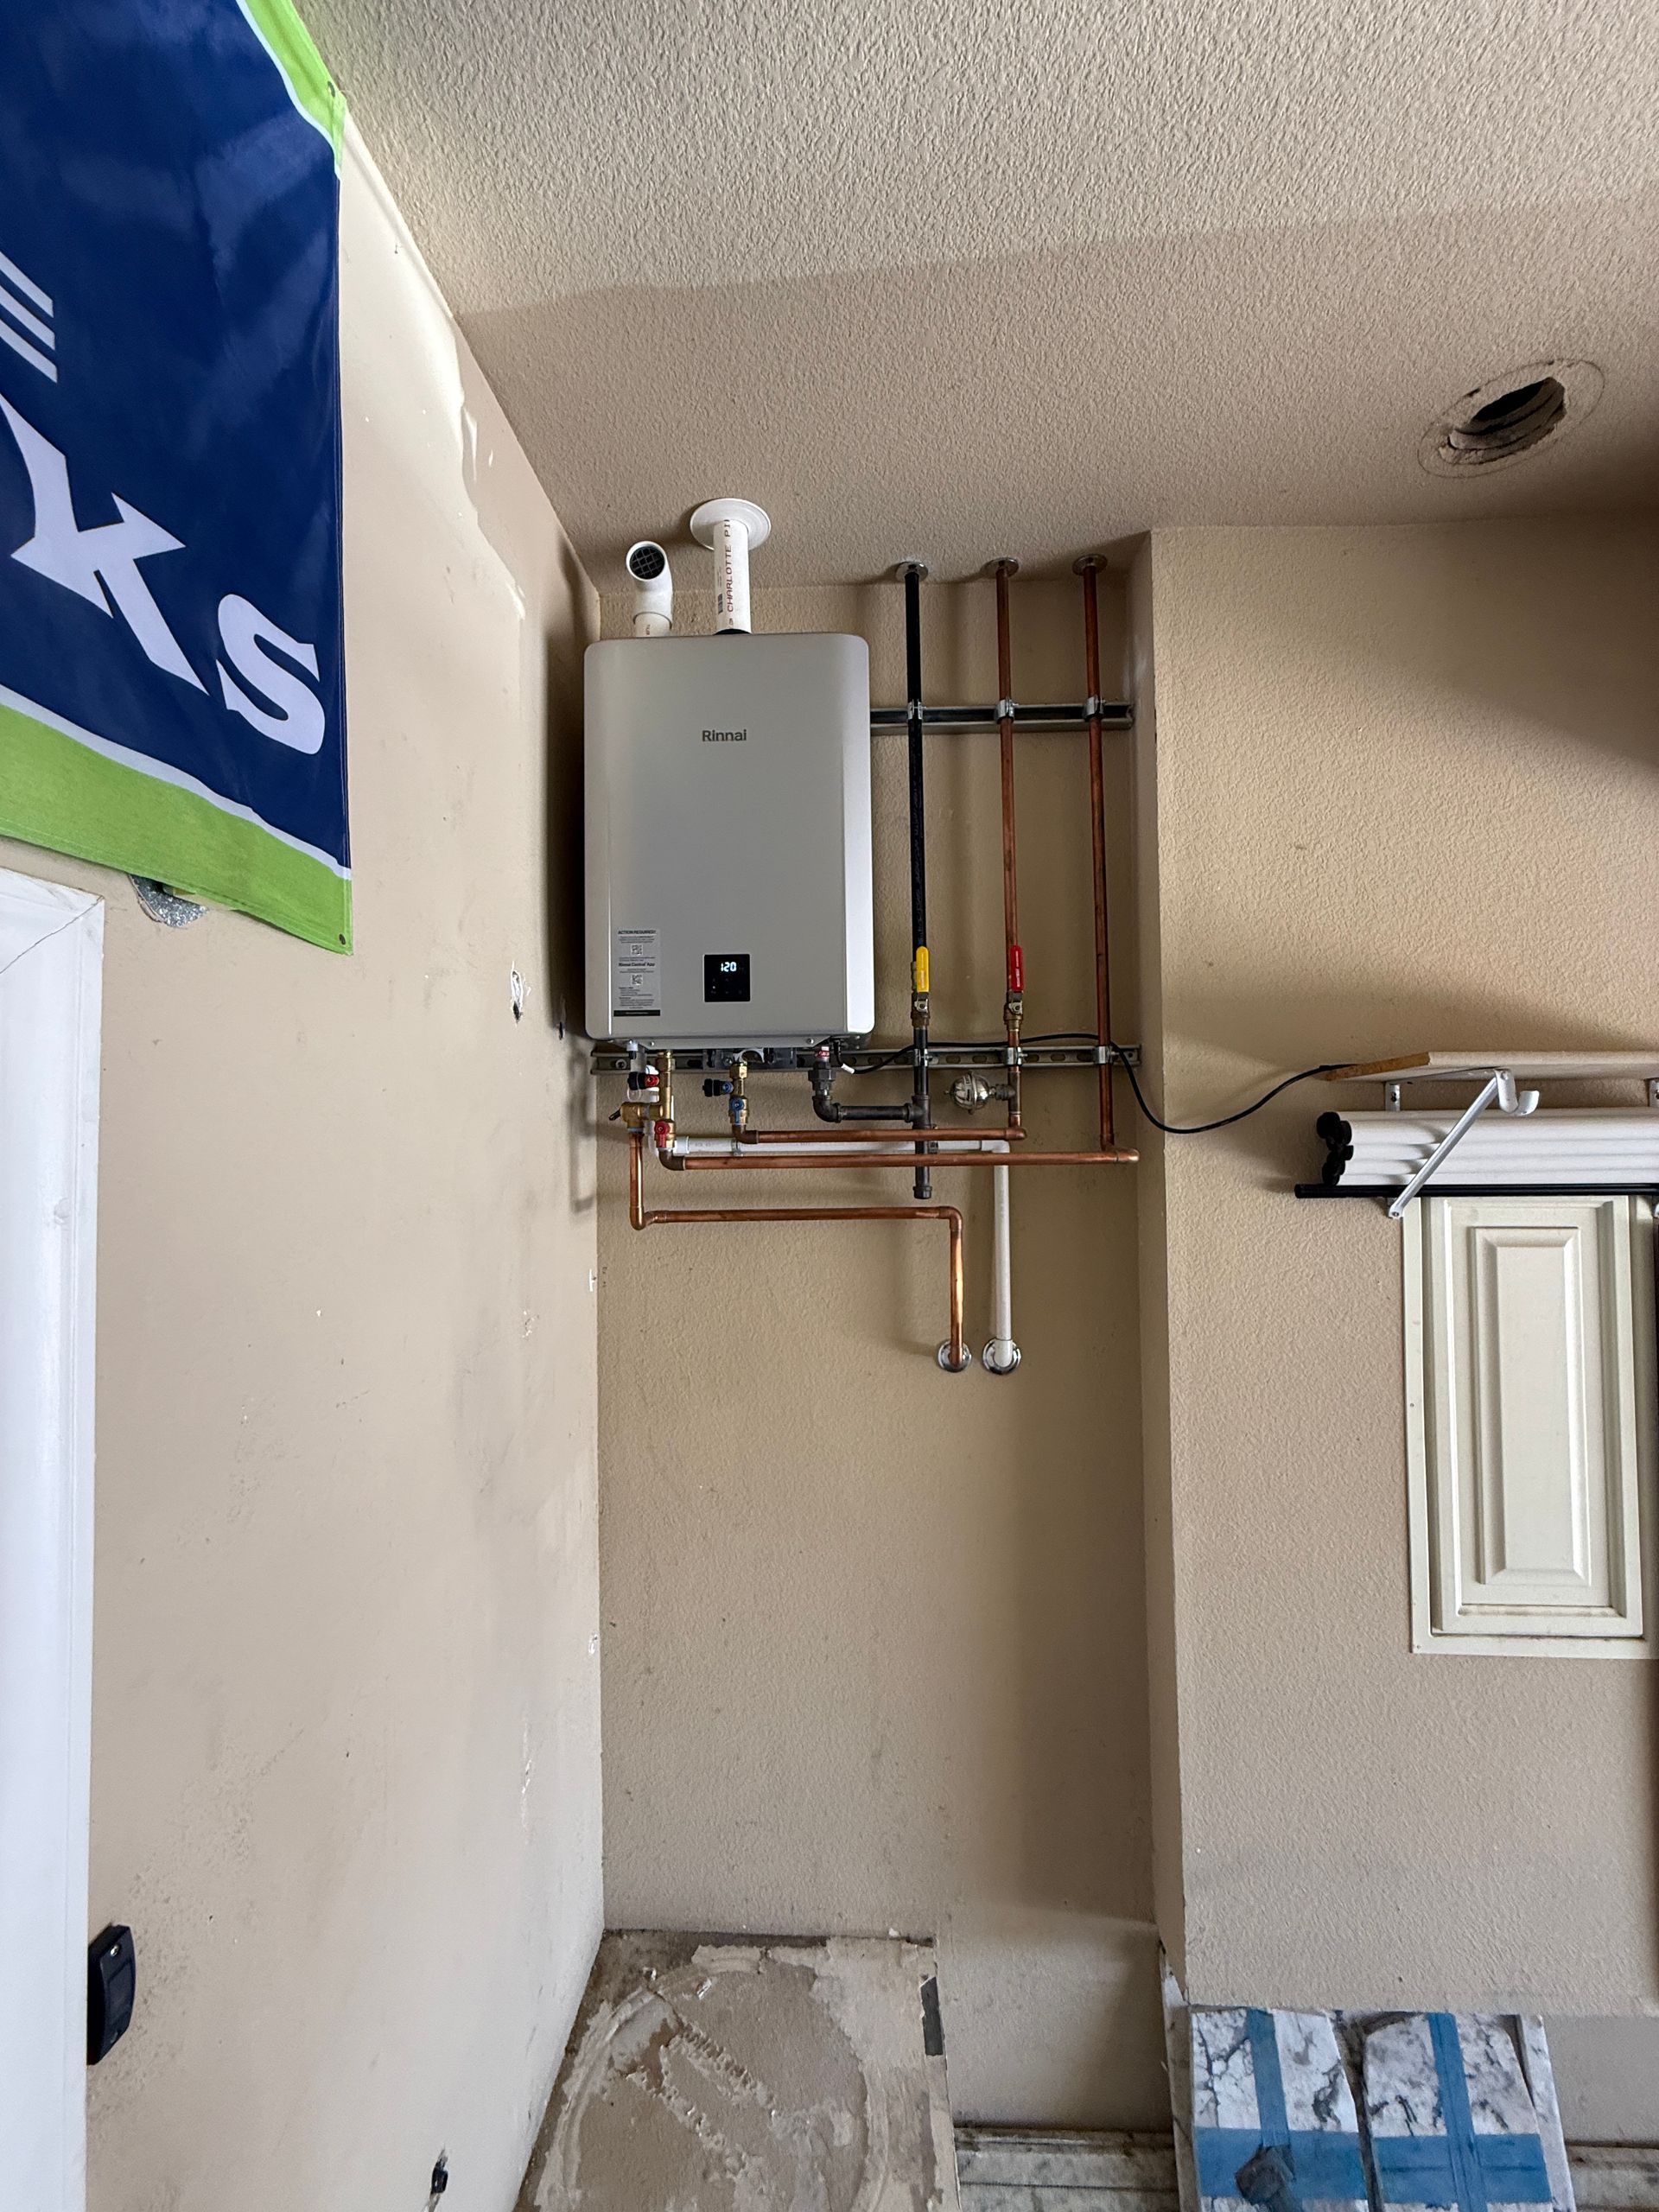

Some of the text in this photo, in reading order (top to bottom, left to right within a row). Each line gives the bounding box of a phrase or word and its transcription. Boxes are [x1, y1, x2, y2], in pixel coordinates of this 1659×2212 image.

[725, 544, 734, 613] CHARLOTTE
[702, 728, 747, 742] Rinnai
[721, 961, 737, 972] 120
